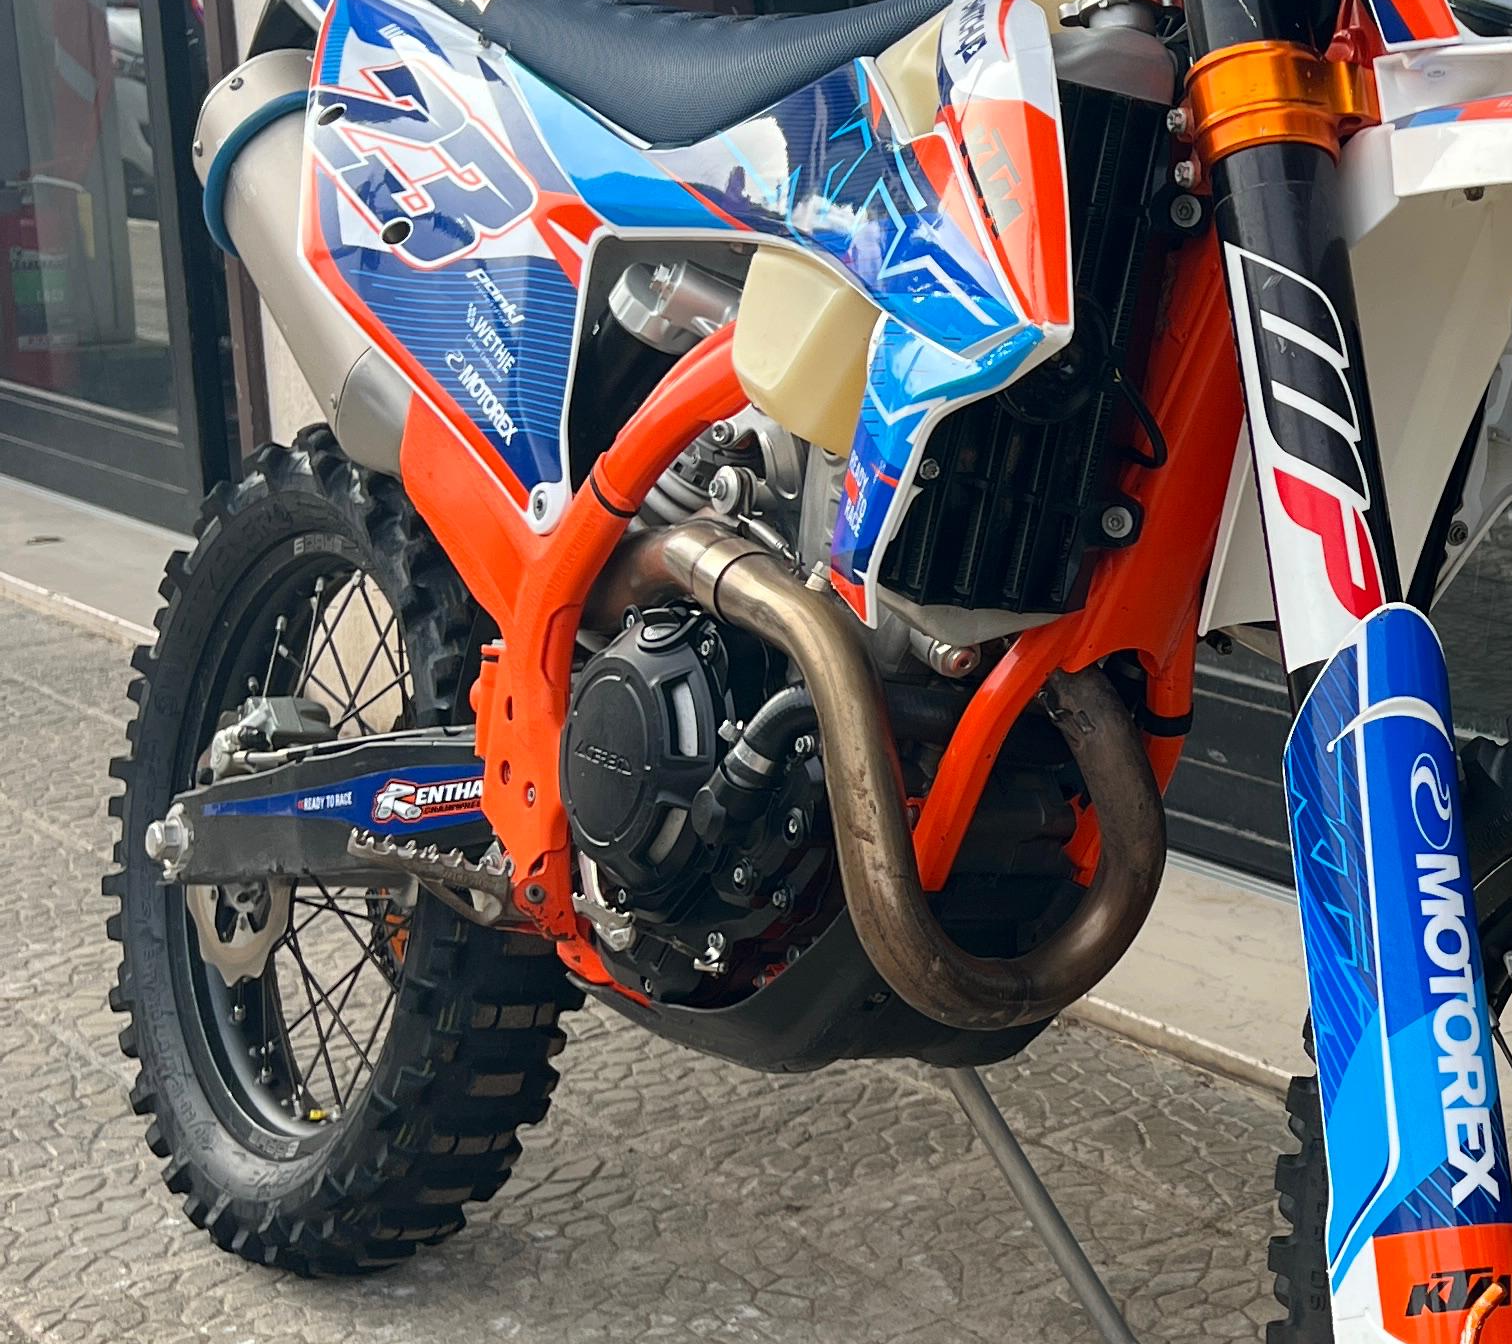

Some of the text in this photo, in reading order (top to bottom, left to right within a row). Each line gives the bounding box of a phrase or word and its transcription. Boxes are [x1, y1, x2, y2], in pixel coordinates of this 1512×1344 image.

[457, 364, 519, 446] MOTOREX
[303, 791, 353, 811] READY TO RACE
[376, 781, 484, 820] RENTHA
[1415, 853, 1500, 1209] MOTOREX
[1405, 1266, 1511, 1317] KTM
